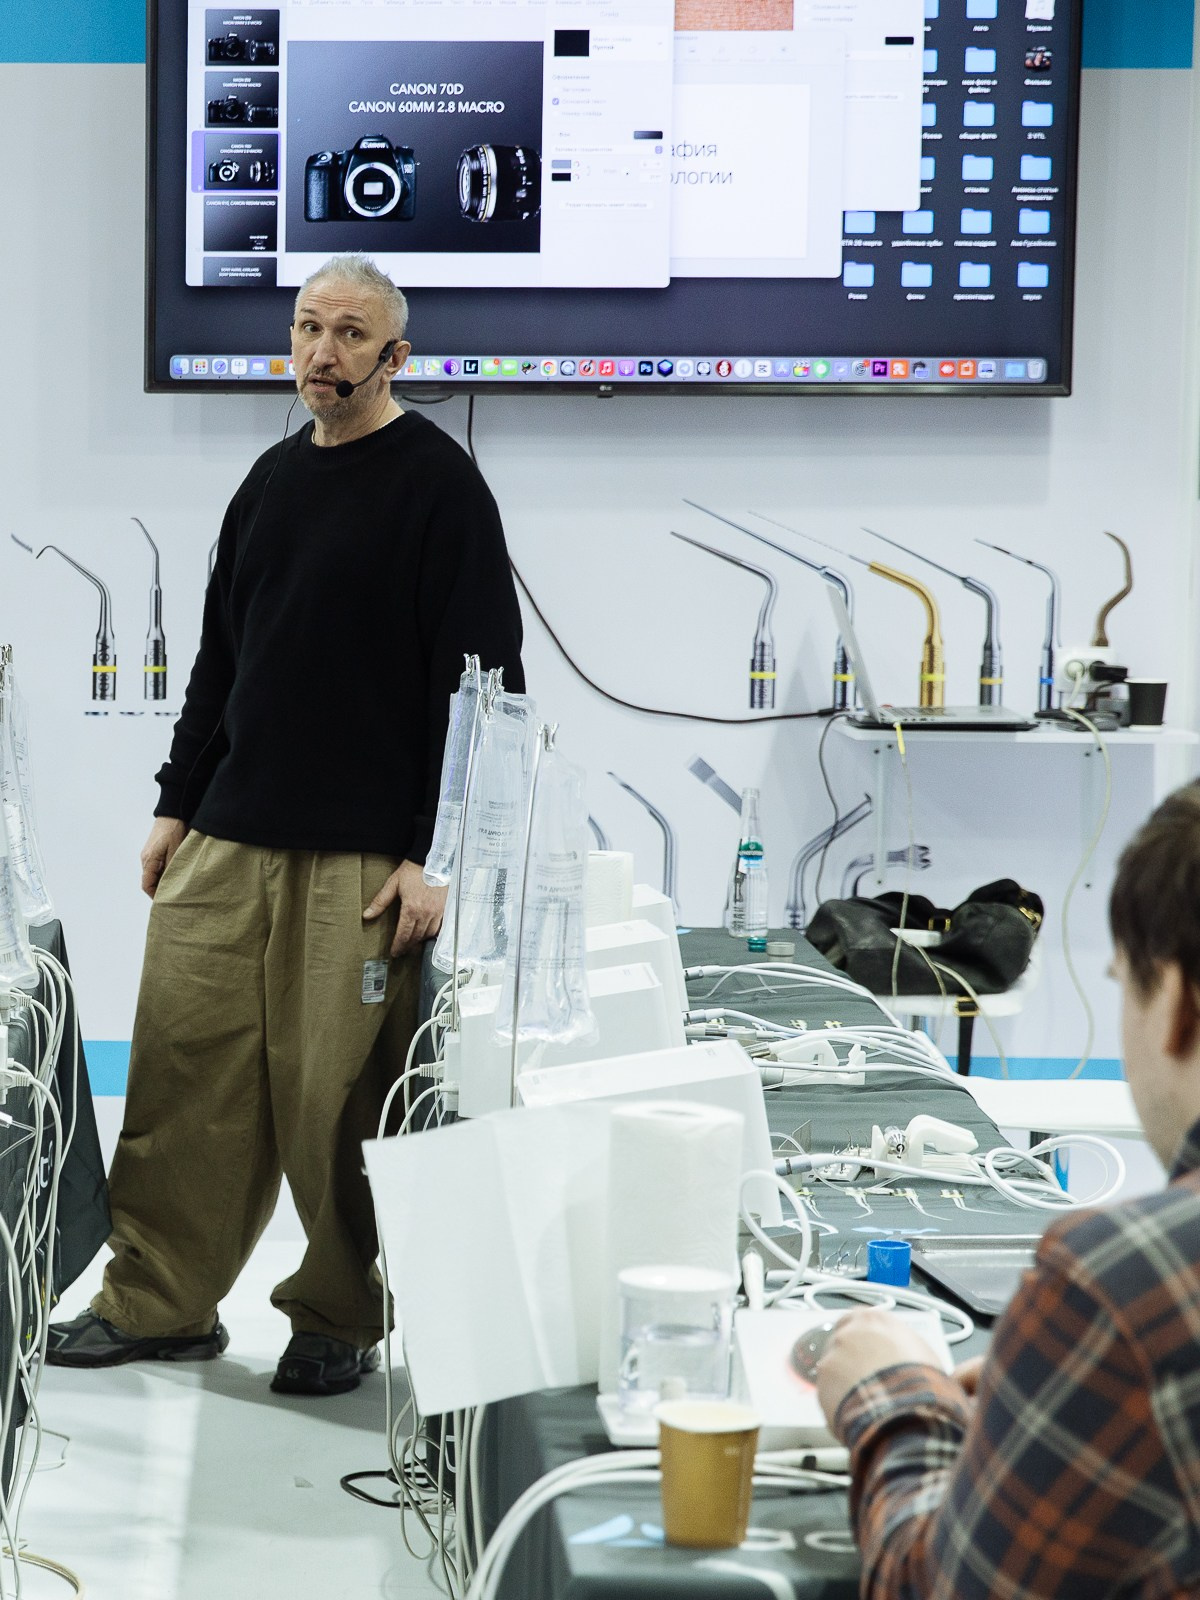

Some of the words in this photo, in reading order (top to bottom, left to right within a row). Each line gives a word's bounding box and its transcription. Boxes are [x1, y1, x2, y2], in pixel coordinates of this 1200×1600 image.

[390, 83, 437, 95] CANON
[439, 83, 465, 95] 70D
[349, 101, 397, 113] CANON
[398, 101, 435, 113] 60MM
[437, 101, 456, 113] 2.8
[458, 101, 505, 113] MACRO
[670, 171, 733, 185] логии
[465, 361, 477, 371] Lr
[640, 363, 652, 373] Ps
[874, 363, 886, 373] Pr
